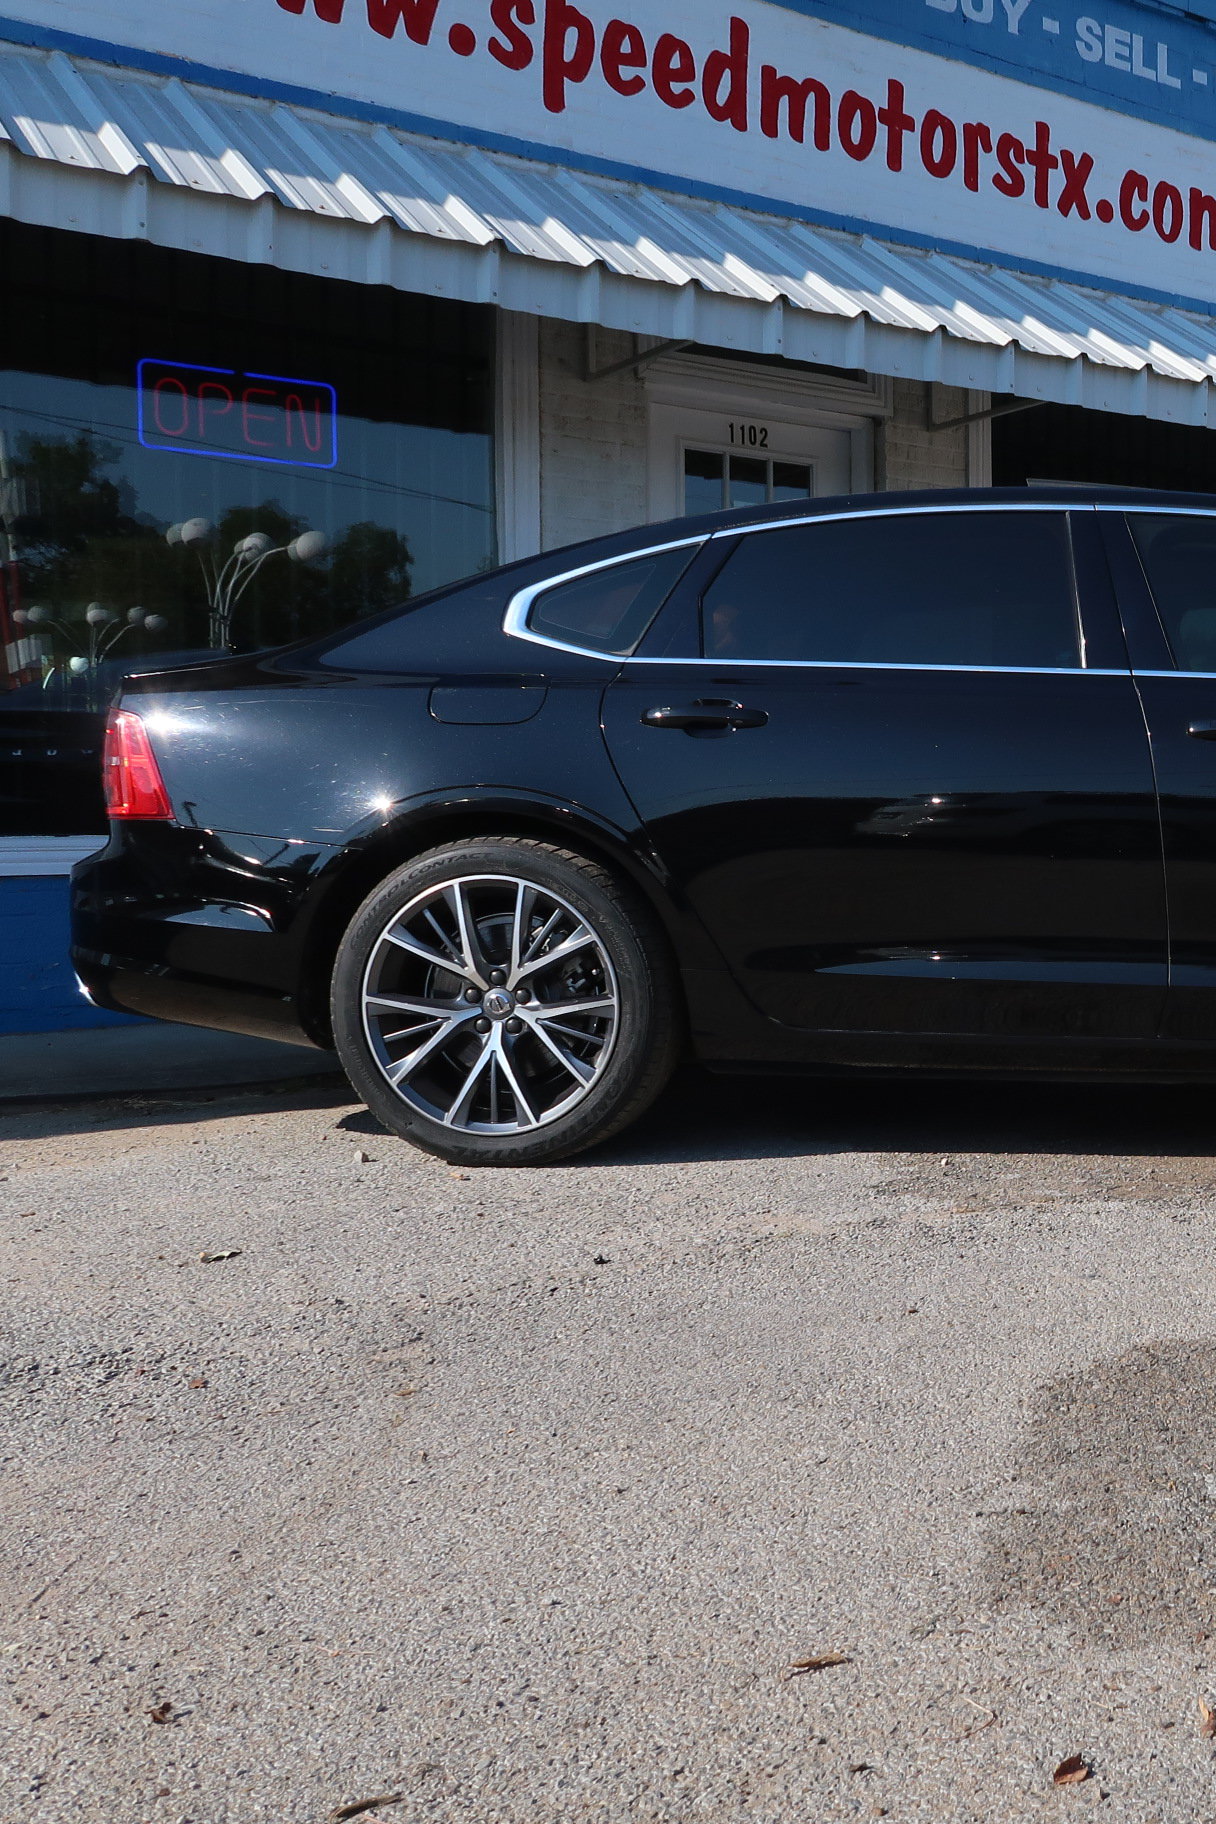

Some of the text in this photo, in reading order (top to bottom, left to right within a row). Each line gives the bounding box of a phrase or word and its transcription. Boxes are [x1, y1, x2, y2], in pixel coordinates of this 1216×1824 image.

[1075, 16, 1181, 89] SELL
[153, 377, 323, 452] OPEN
[728, 422, 769, 448] 1102
